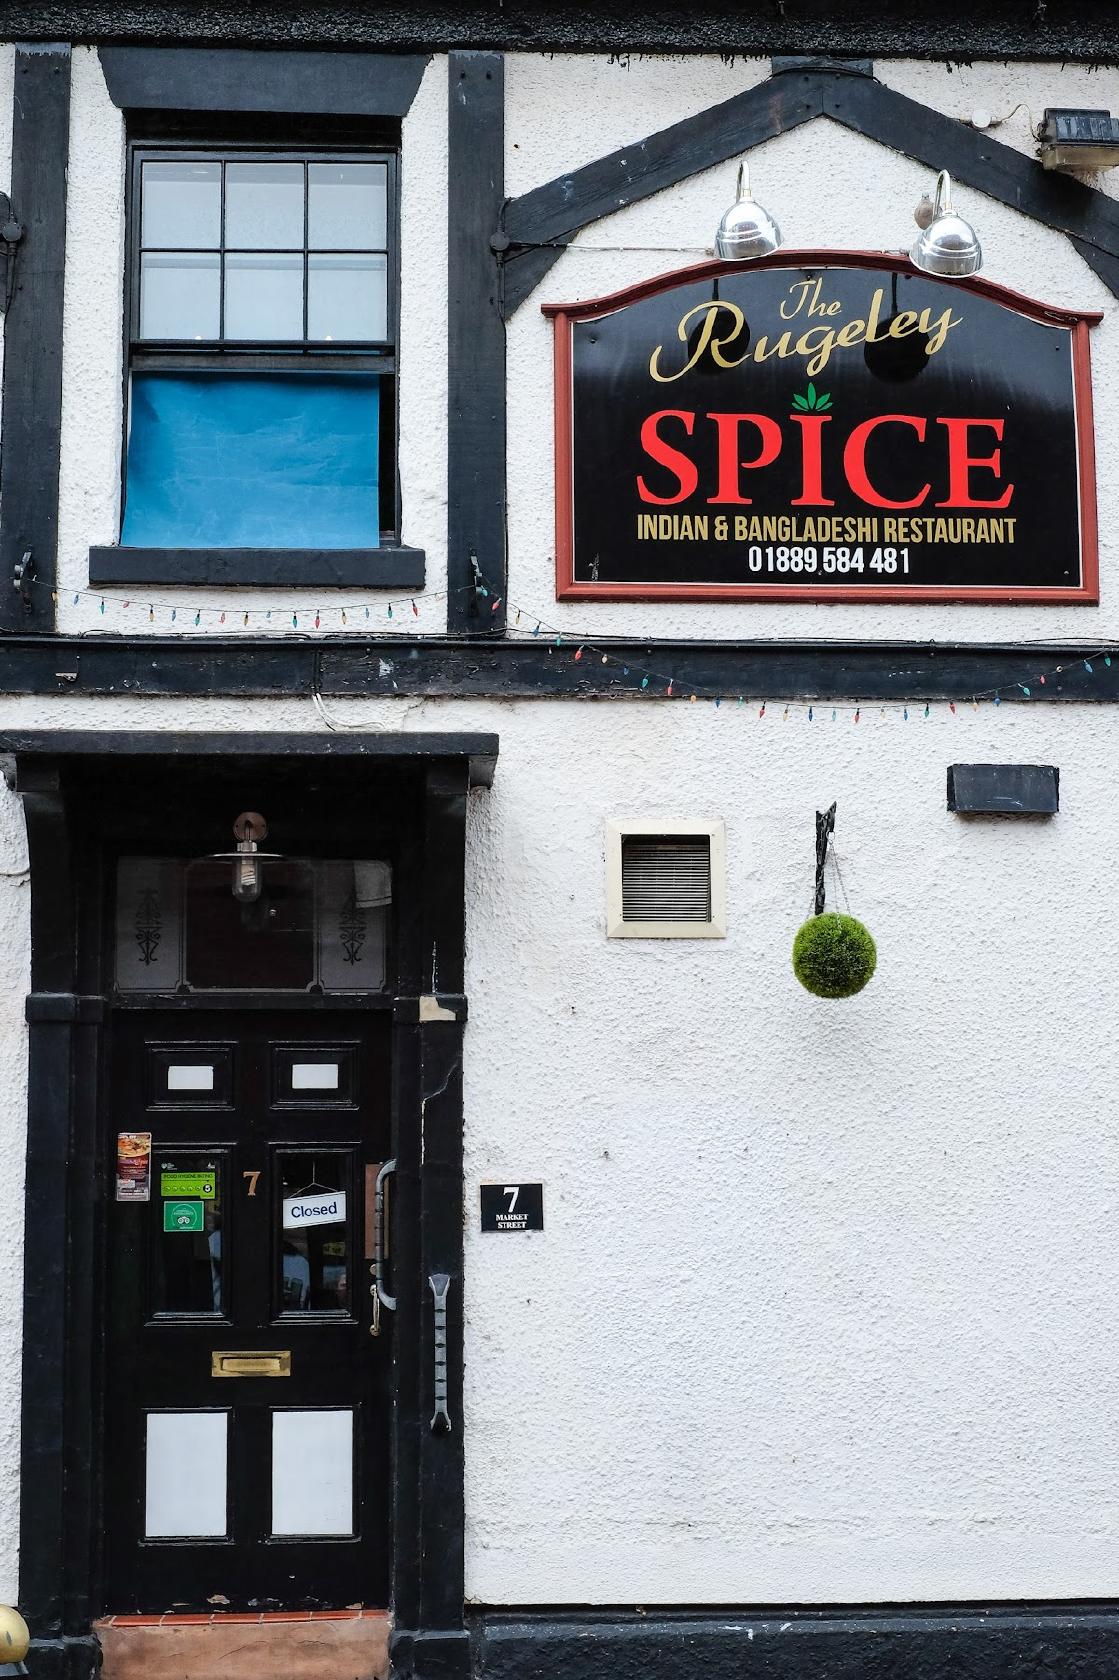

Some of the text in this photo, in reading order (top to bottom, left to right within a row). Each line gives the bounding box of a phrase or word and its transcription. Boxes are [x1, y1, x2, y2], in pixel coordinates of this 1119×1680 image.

[779, 277, 842, 320] The
[648, 287, 963, 383] Rugeley
[636, 409, 1015, 509] SPICE
[637, 514, 1017, 544] INDIAN & BANGLADESHI RESTAURANT
[749, 546, 910, 574] 01889 584 481
[242, 1171, 261, 1197] 7
[291, 1201, 338, 1219] Closed
[503, 1186, 520, 1213] 7
[495, 1213, 529, 1221] MARKET
[497, 1221, 527, 1229] STREET
